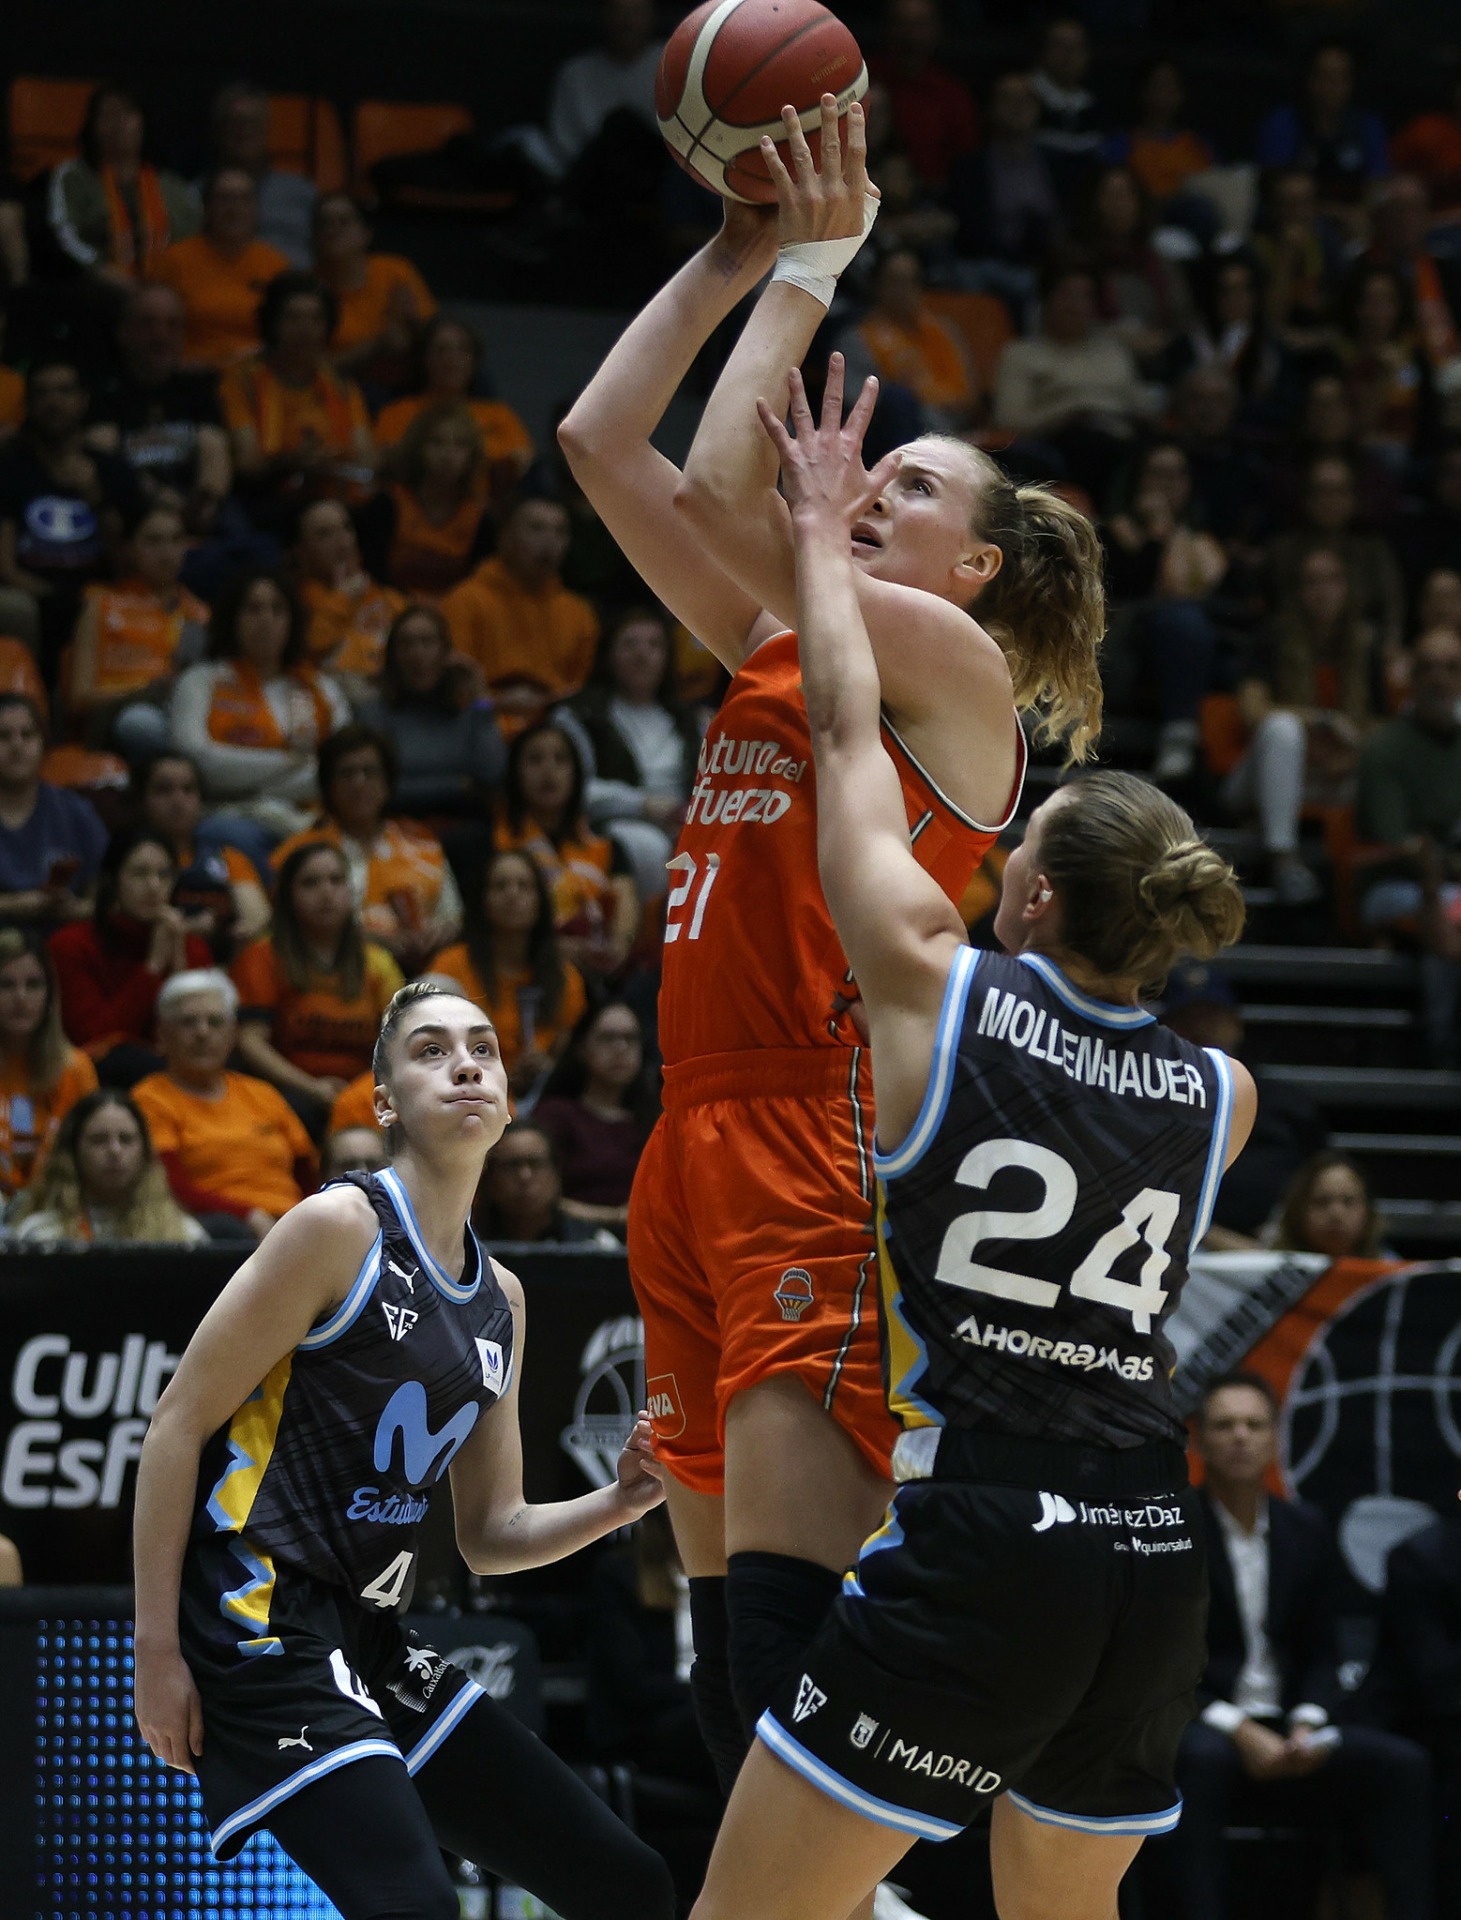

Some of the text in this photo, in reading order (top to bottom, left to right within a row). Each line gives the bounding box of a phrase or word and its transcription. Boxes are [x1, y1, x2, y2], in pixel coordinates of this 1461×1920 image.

[685, 776, 791, 825] fuerzo
[770, 755, 807, 783] del
[664, 851, 720, 943] 21
[976, 986, 1207, 1109] MOLLENHAUER
[934, 1138, 1181, 1335] 24
[12, 1332, 182, 1419] Cult
[2, 1419, 148, 1509] Esf
[360, 1550, 414, 1608] 4
[887, 1737, 1002, 1794] MADRID
